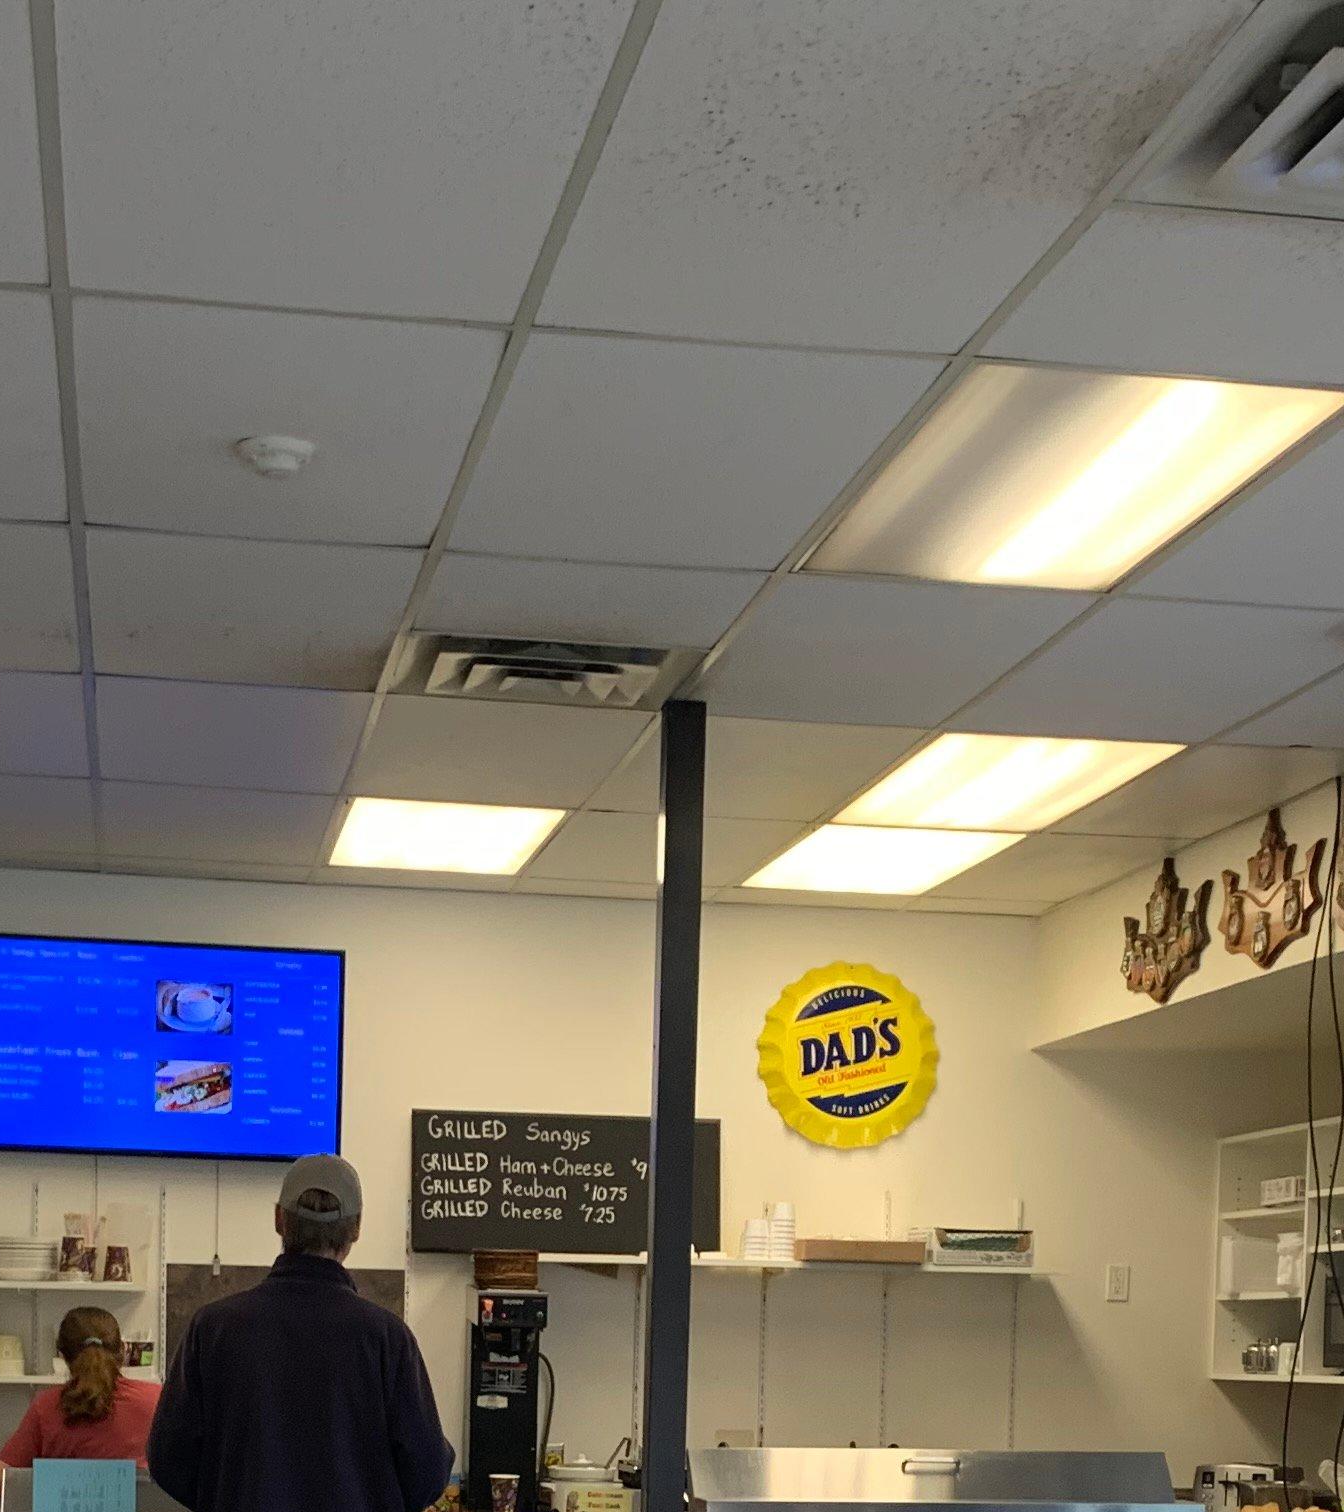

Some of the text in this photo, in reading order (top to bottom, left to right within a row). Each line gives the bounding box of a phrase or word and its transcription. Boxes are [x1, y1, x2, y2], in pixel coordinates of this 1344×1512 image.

[811, 988, 866, 1010] DELICIOUS
[800, 1016, 902, 1077] DAD'S
[831, 1093, 891, 1115] SOFT DRINKS
[428, 1115, 591, 1150] GRILLED Sangys
[420, 1152, 489, 1172] GRILLED
[420, 1175, 492, 1196] GRILLED
[502, 1176, 567, 1200] Reuban
[421, 1199, 489, 1219] GRILLED
[500, 1201, 563, 1220] Cheese
